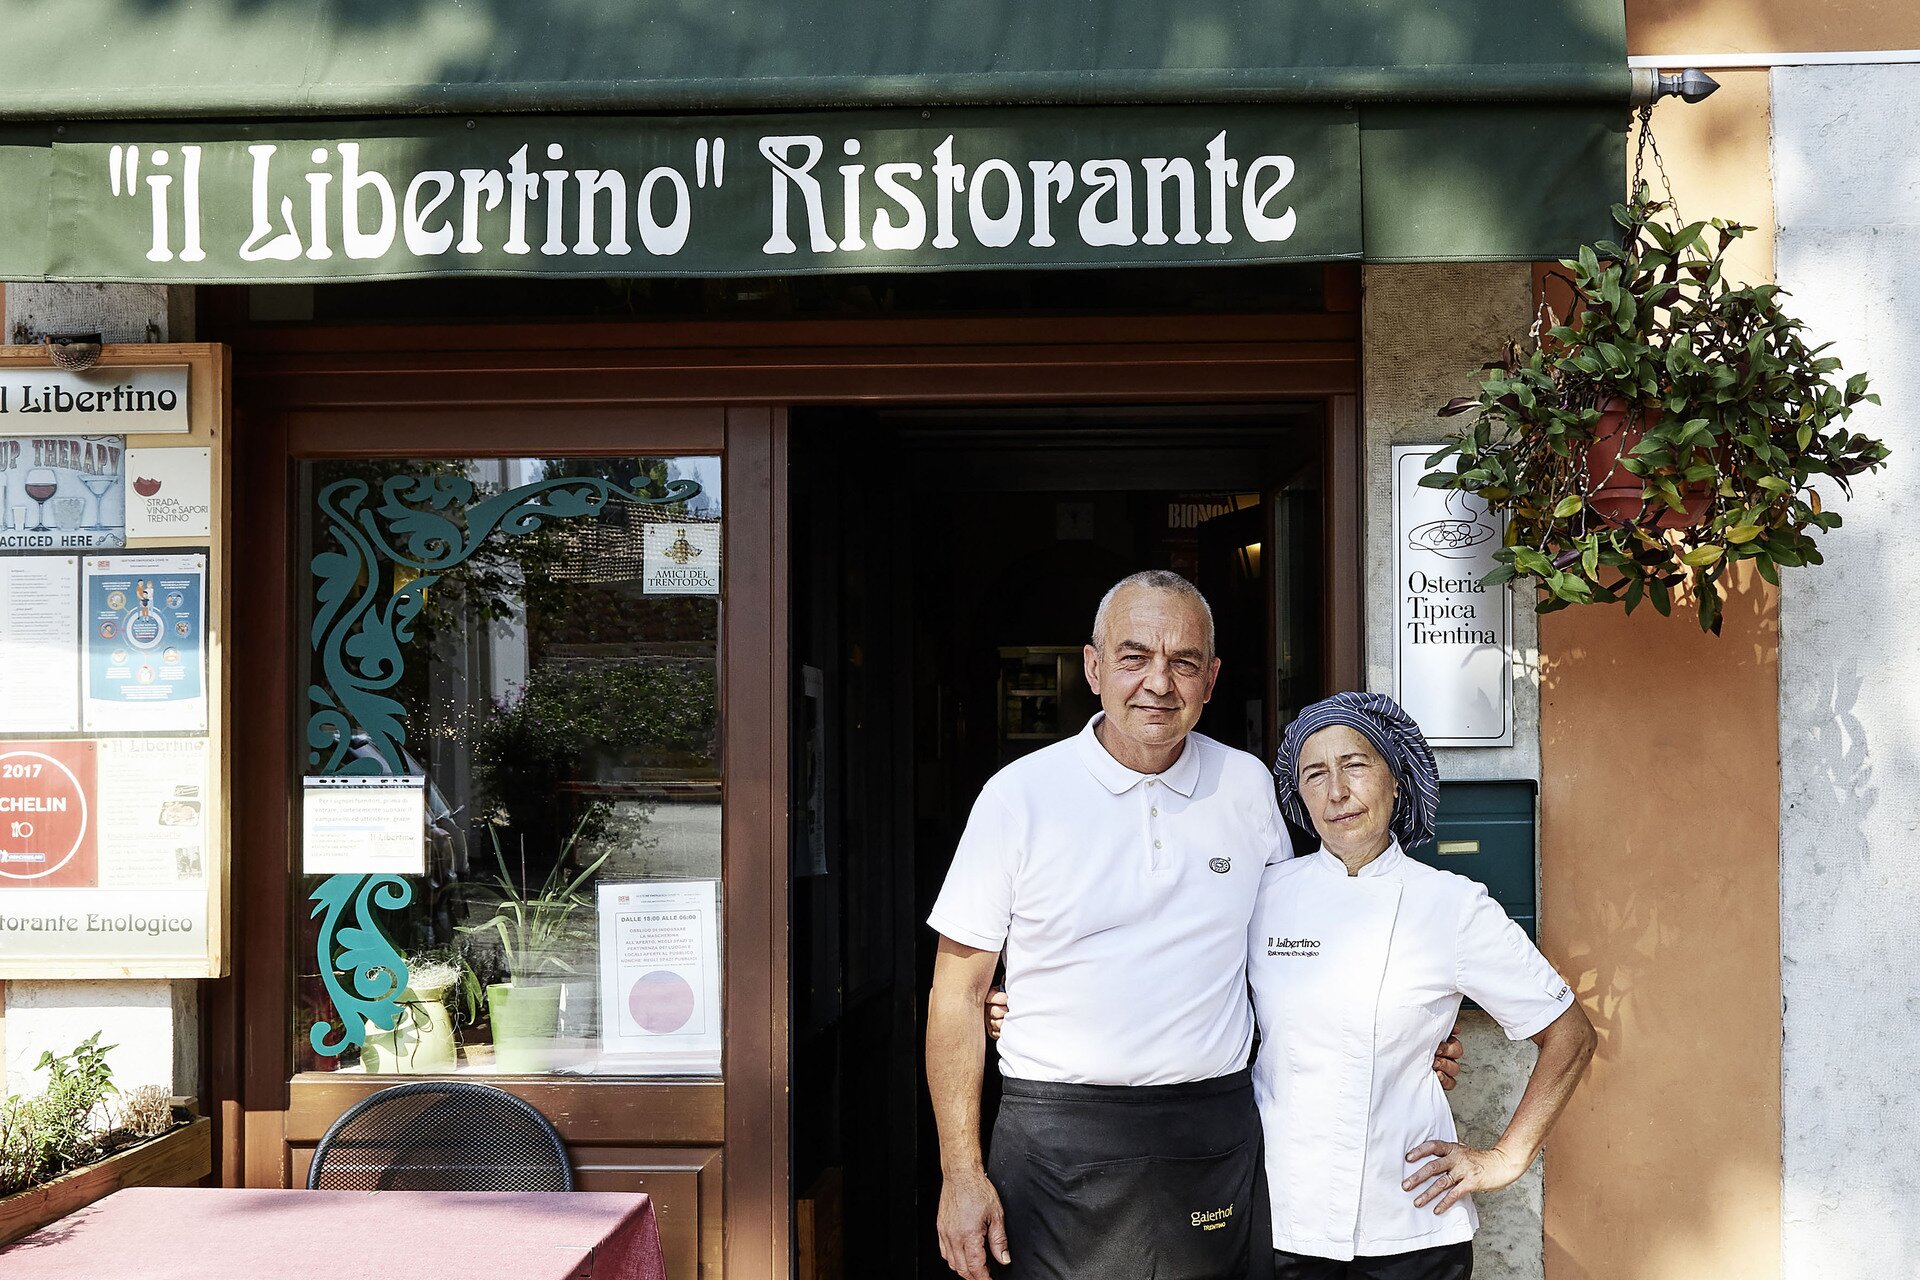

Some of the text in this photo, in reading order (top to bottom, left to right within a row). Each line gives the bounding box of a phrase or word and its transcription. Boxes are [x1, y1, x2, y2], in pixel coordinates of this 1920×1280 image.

[109, 129, 1297, 262] "il Libertino" Ristorante
[19, 385, 177, 413] Libertino
[32, 439, 120, 476] THERAPY
[147, 498, 179, 506] STRADA
[146, 506, 170, 514] VINO
[178, 505, 208, 514] SAPORI
[147, 514, 189, 522] TRENTINO
[0, 535, 93, 547] ACTICED HERE
[655, 570, 708, 578] AMICI DEL
[647, 578, 715, 586] TRENTODOC
[1408, 570, 1487, 594] Osteria
[1407, 596, 1476, 625] Tipica
[1407, 622, 1497, 645] Trentina
[130, 739, 202, 753] Libertino
[3, 764, 42, 778] 2017
[377, 832, 414, 841] Libertino
[86, 913, 193, 936] Enologico
[1276, 937, 1321, 949] Libertino
[1190, 1203, 1234, 1227] gaierhof
